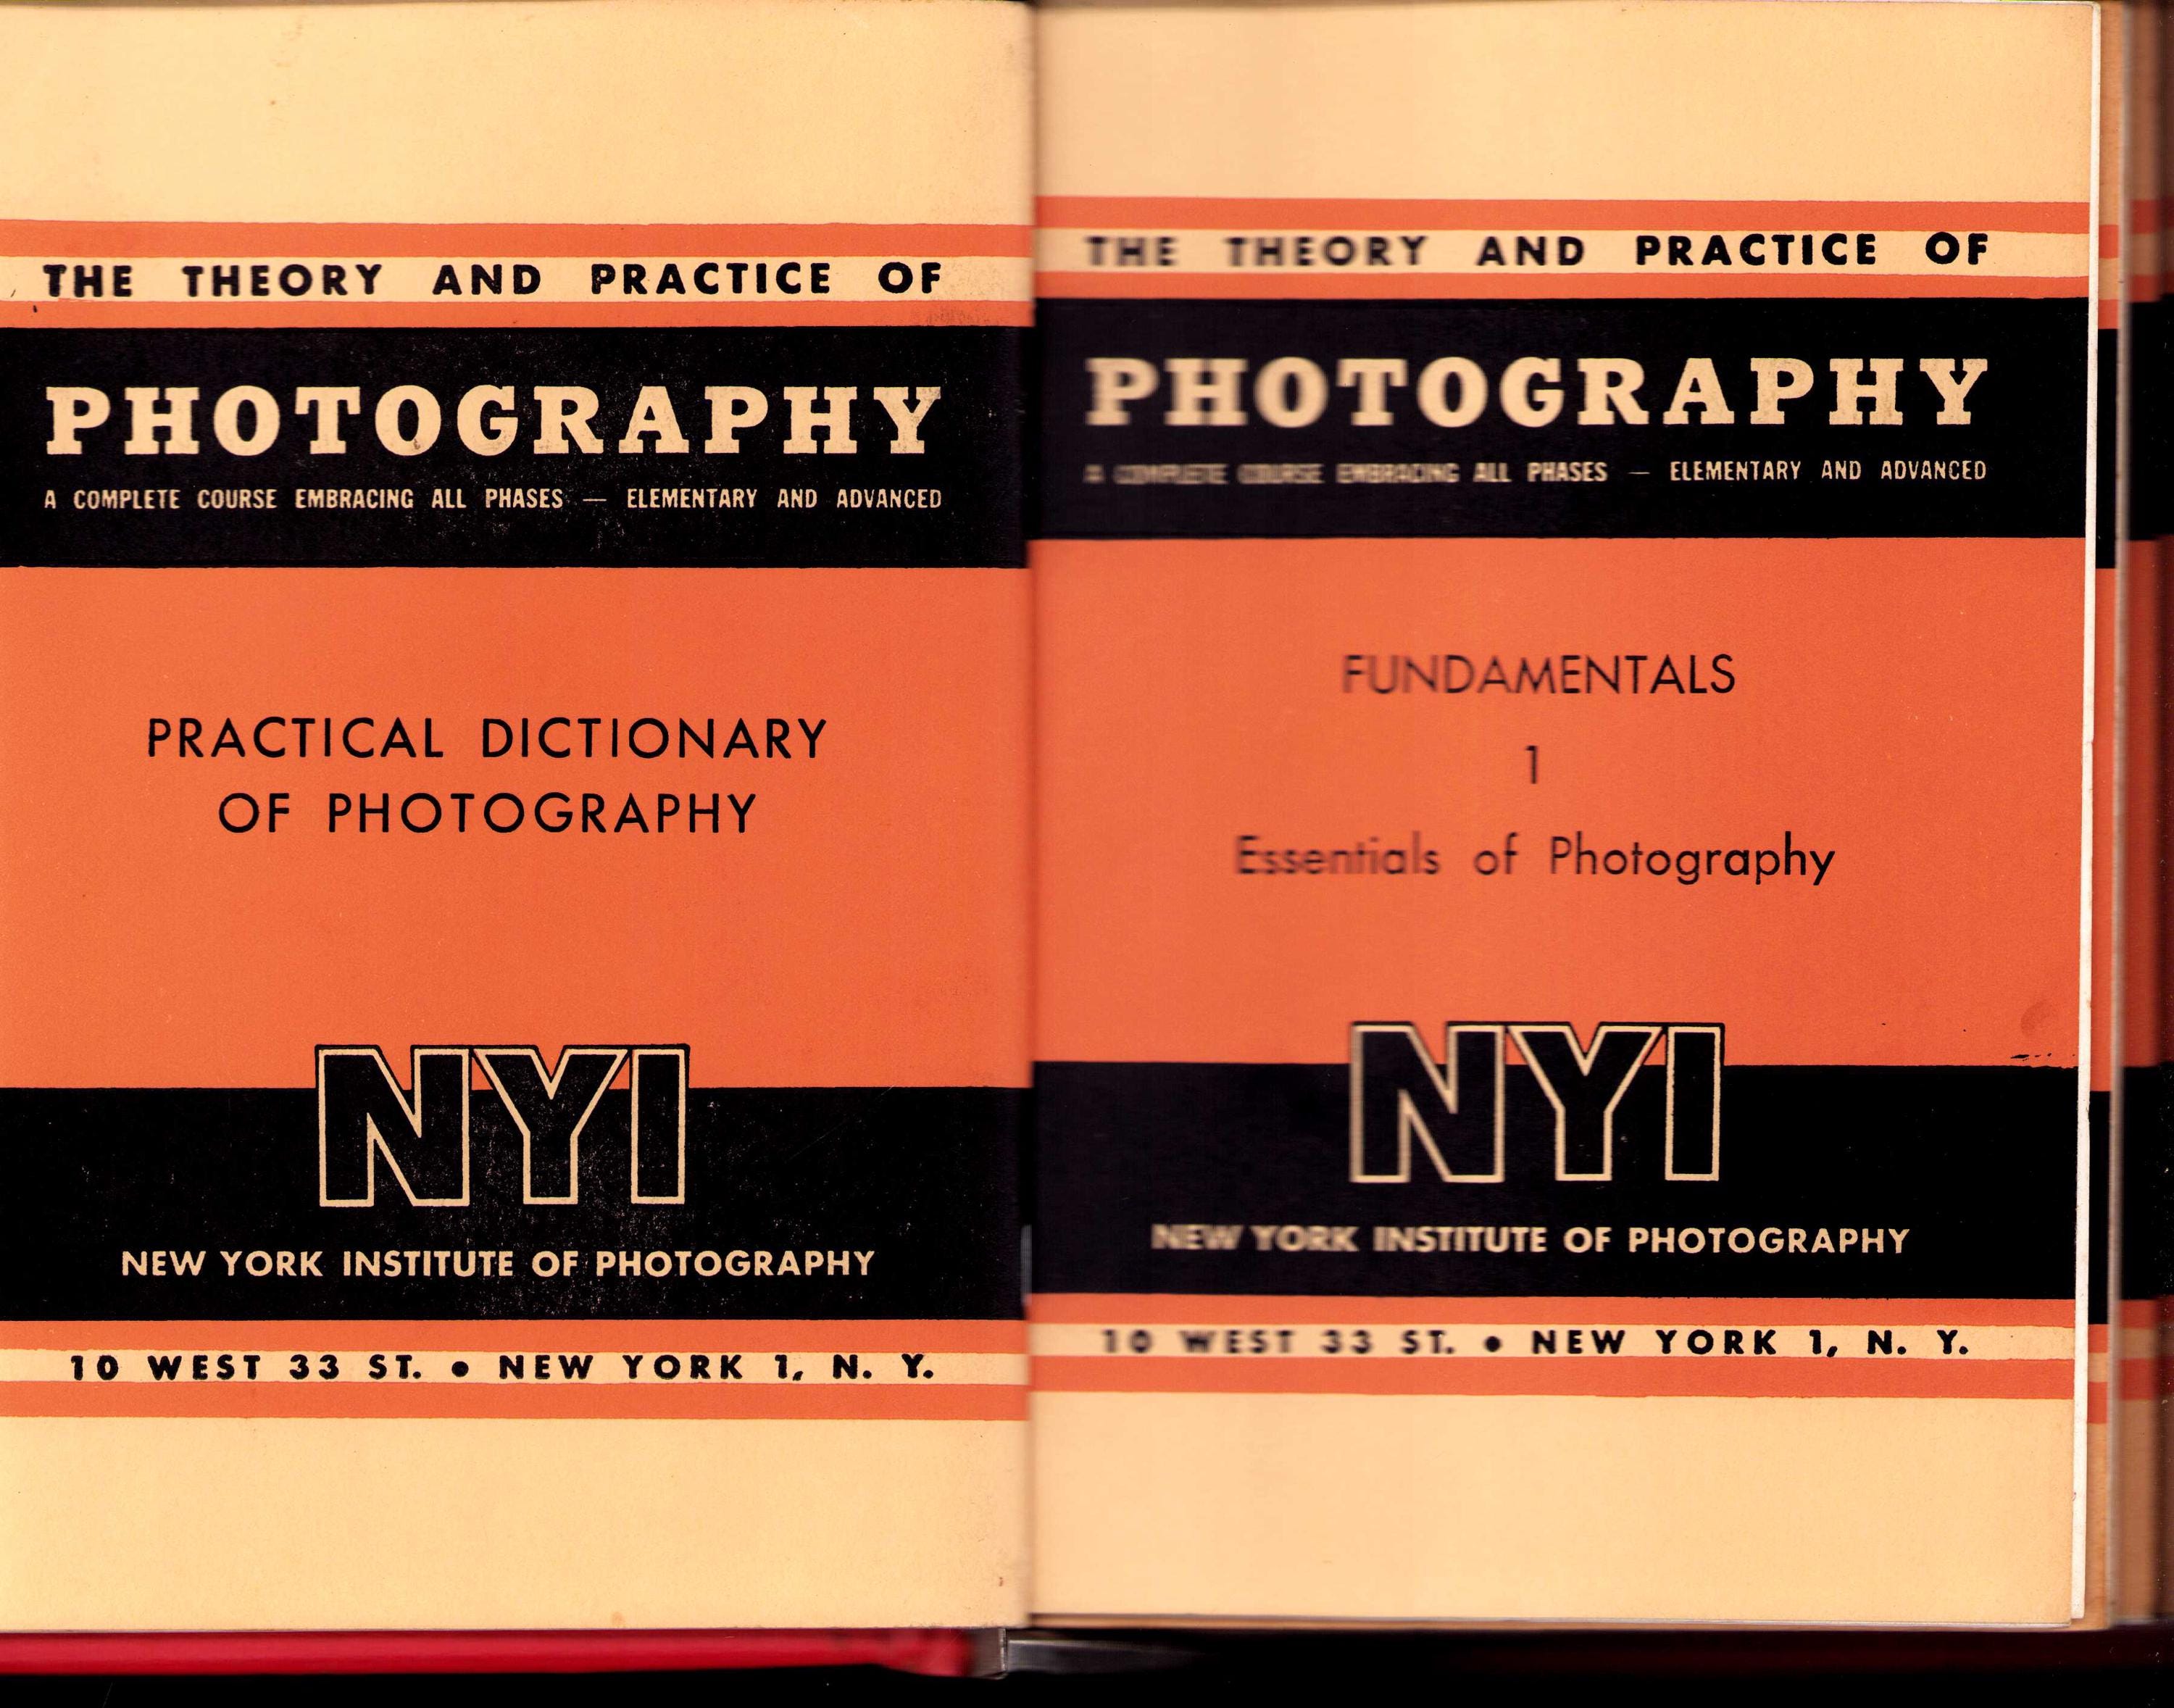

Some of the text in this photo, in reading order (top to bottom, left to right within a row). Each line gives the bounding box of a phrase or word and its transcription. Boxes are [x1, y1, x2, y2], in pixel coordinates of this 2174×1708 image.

[1086, 231, 1988, 267] THE THEORY AND PRACTICE OF
[43, 262, 941, 298] THE THEORY AND PRACTICE OF
[1087, 356, 1988, 428] PHOTOGRAPHY
[46, 384, 941, 457] PHOTOGRAPHY
[1336, 462, 1459, 484] EMBRACING
[1473, 462, 1512, 483] ALL
[1527, 461, 1608, 483] PHASES
[1670, 460, 1802, 482] ELEMENTARY
[1821, 459, 1862, 480] AND
[1881, 459, 1987, 480] ADVANCED
[44, 489, 57, 509] A
[73, 488, 180, 510] COMPLETE
[196, 488, 278, 509] COURSE
[295, 488, 414, 509] EMBRACING
[431, 488, 467, 509] ALL
[485, 487, 564, 509] PHASES
[627, 488, 757, 509] ELEMENTARY
[777, 488, 818, 509] AND
[836, 488, 942, 509] ADVANCED
[1343, 653, 1736, 695] FUNDAMENTALS
[148, 716, 827, 759] PRACTICAL DICTIONARY
[218, 791, 756, 833] OF PHOTOGRAPHY
[1234, 830, 1836, 886] Essentials of Photography
[1349, 1022, 1725, 1183] NYI
[315, 1044, 690, 1207] NYI
[1151, 1224, 1910, 1254] NEW YORK INSTITUTE OF PHOTOGRAPHY
[122, 1249, 875, 1278] NEW YORK INSTITUTE OF PHOTOGRAPHY
[1101, 1329, 1969, 1358] 10 WEST 33 ST. NEW YORK 1, N. Y.
[70, 1353, 934, 1381] 10 WEST 33 ST. NEW YORK 1, N. Y.
